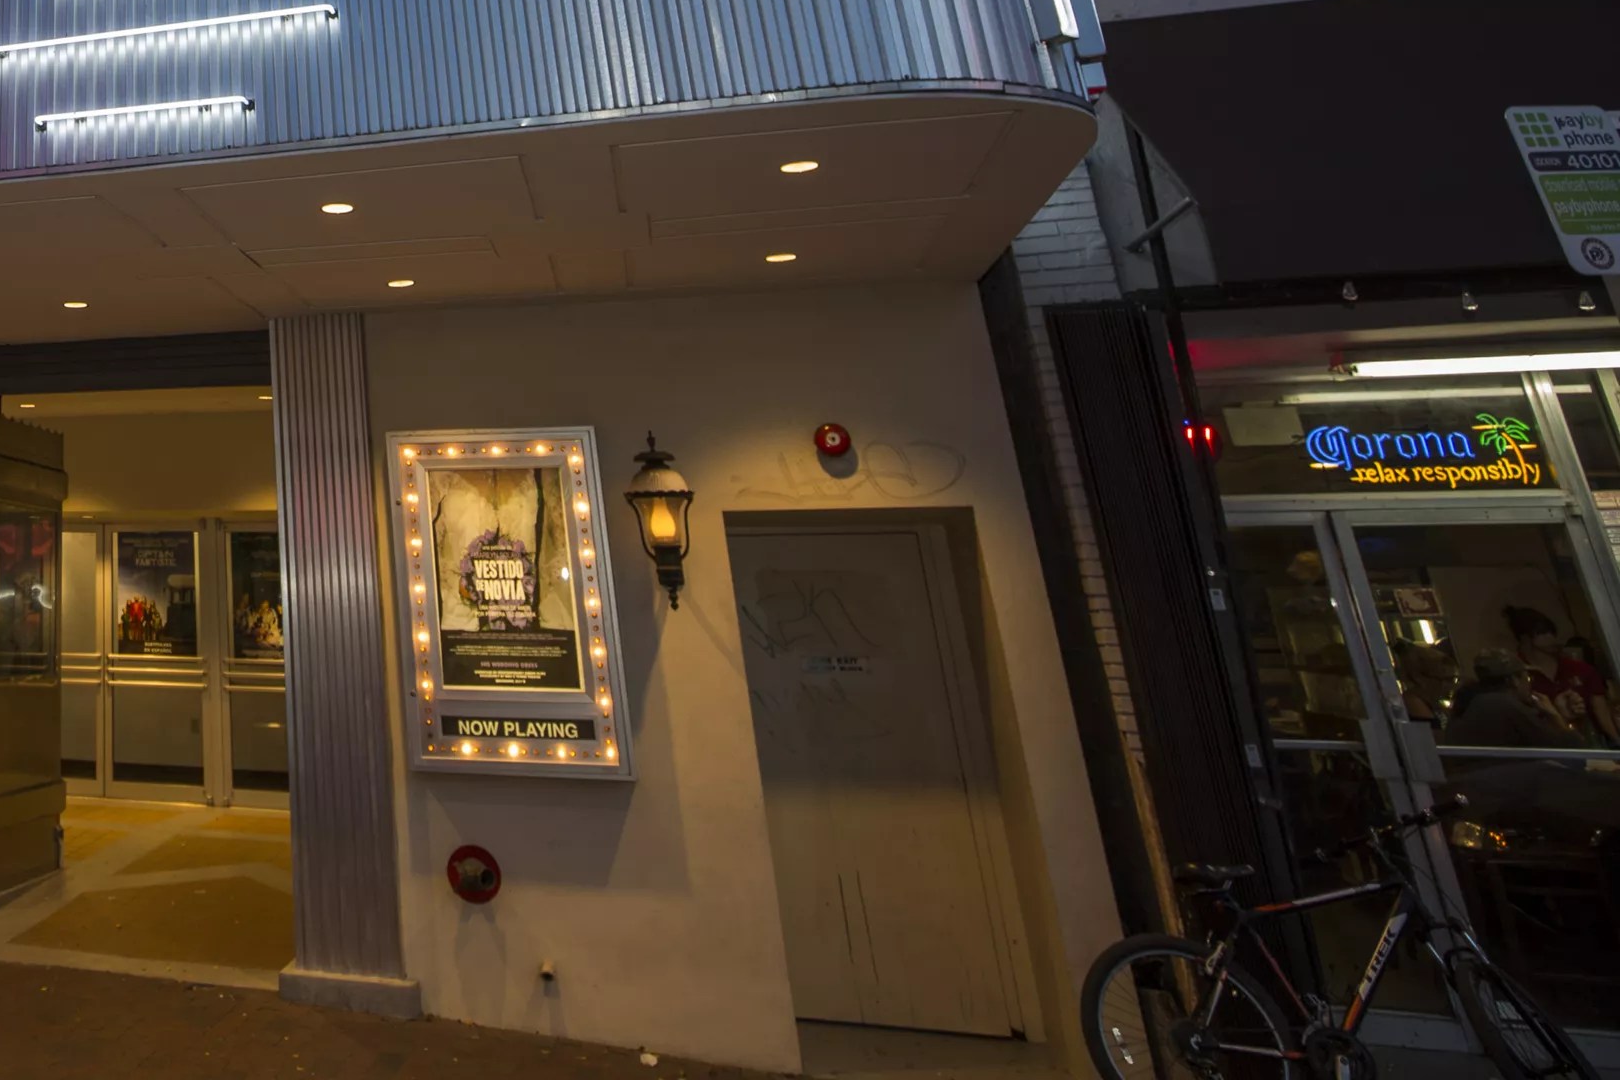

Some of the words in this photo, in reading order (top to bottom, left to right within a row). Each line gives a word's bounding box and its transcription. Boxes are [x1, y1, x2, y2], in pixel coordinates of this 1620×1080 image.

[1563, 131, 1616, 149] phone
[1305, 425, 1476, 472] Corona
[1350, 461, 1410, 484] relax
[1412, 458, 1542, 490] responsibly
[474, 559, 524, 579] VESTIDO
[484, 579, 526, 601] NOVIA
[457, 719, 499, 737] NOW
[503, 721, 579, 739] PLAYING
